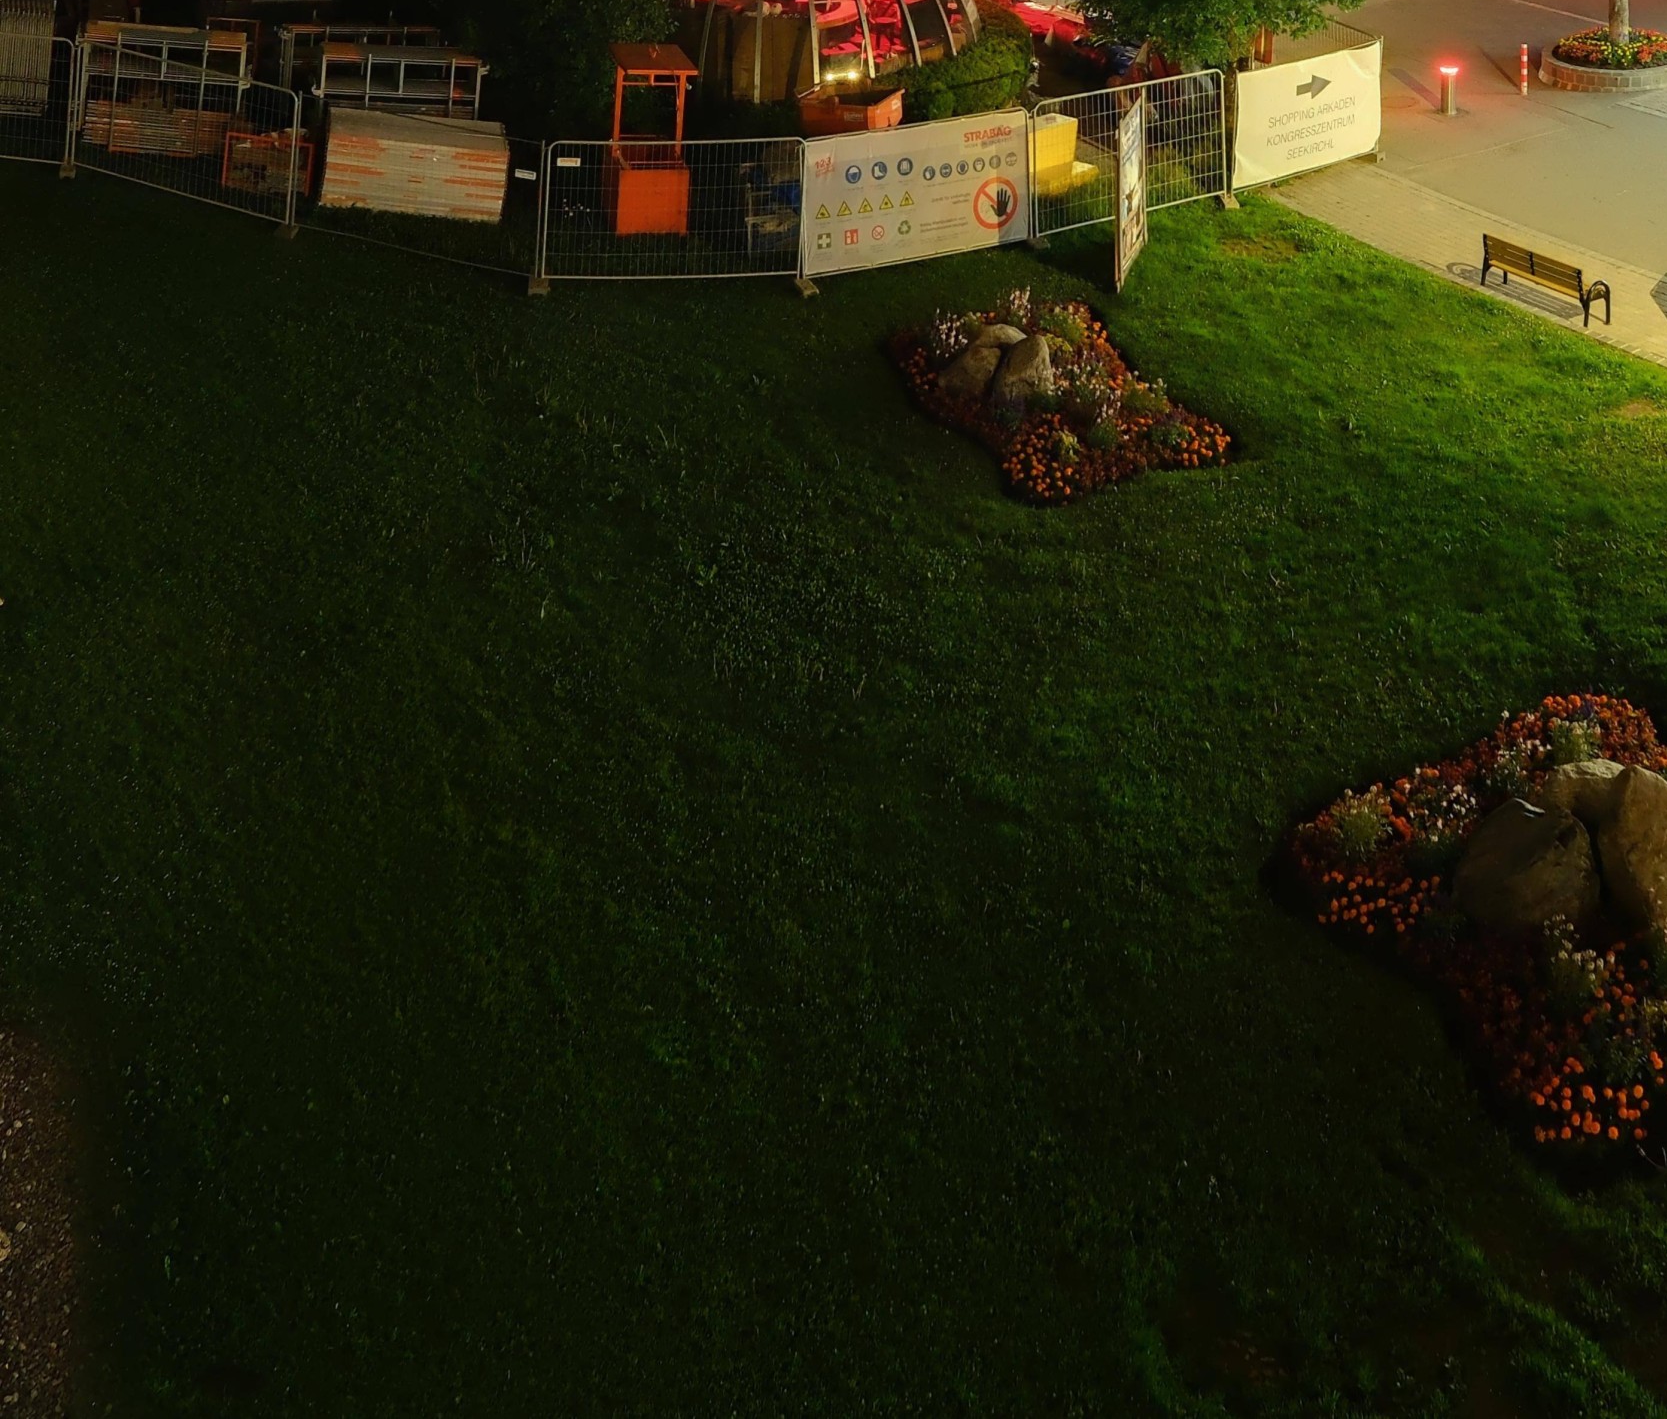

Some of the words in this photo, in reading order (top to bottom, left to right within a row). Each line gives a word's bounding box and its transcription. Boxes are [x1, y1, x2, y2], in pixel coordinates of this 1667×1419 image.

[1267, 107, 1315, 129] SHOPPING
[1316, 96, 1356, 116] ARKADEN
[964, 125, 1012, 143] STRABAG
[1266, 114, 1356, 147] KONGRESSZENTRUM
[1286, 139, 1335, 160] SEEKIRCHL
